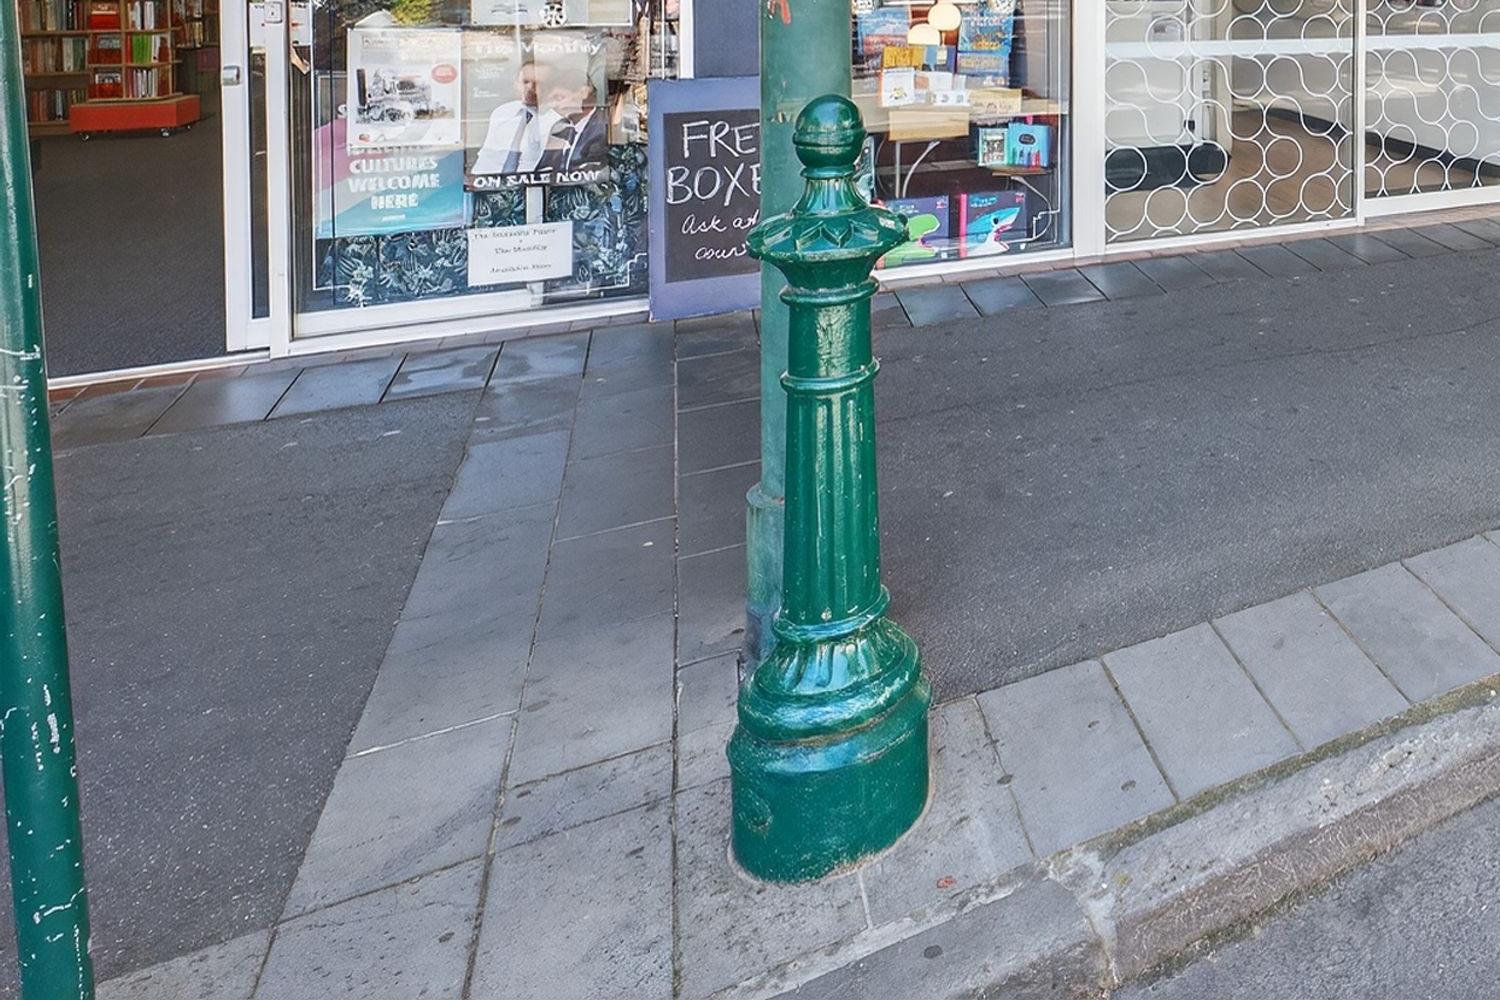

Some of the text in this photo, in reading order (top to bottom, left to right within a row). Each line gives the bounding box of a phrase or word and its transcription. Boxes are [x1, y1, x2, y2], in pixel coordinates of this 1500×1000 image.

[349, 158, 438, 173] CULTURES
[347, 173, 440, 192] WELCOME
[473, 170, 601, 188] ON SALE NOW
[371, 193, 418, 209] HERE
